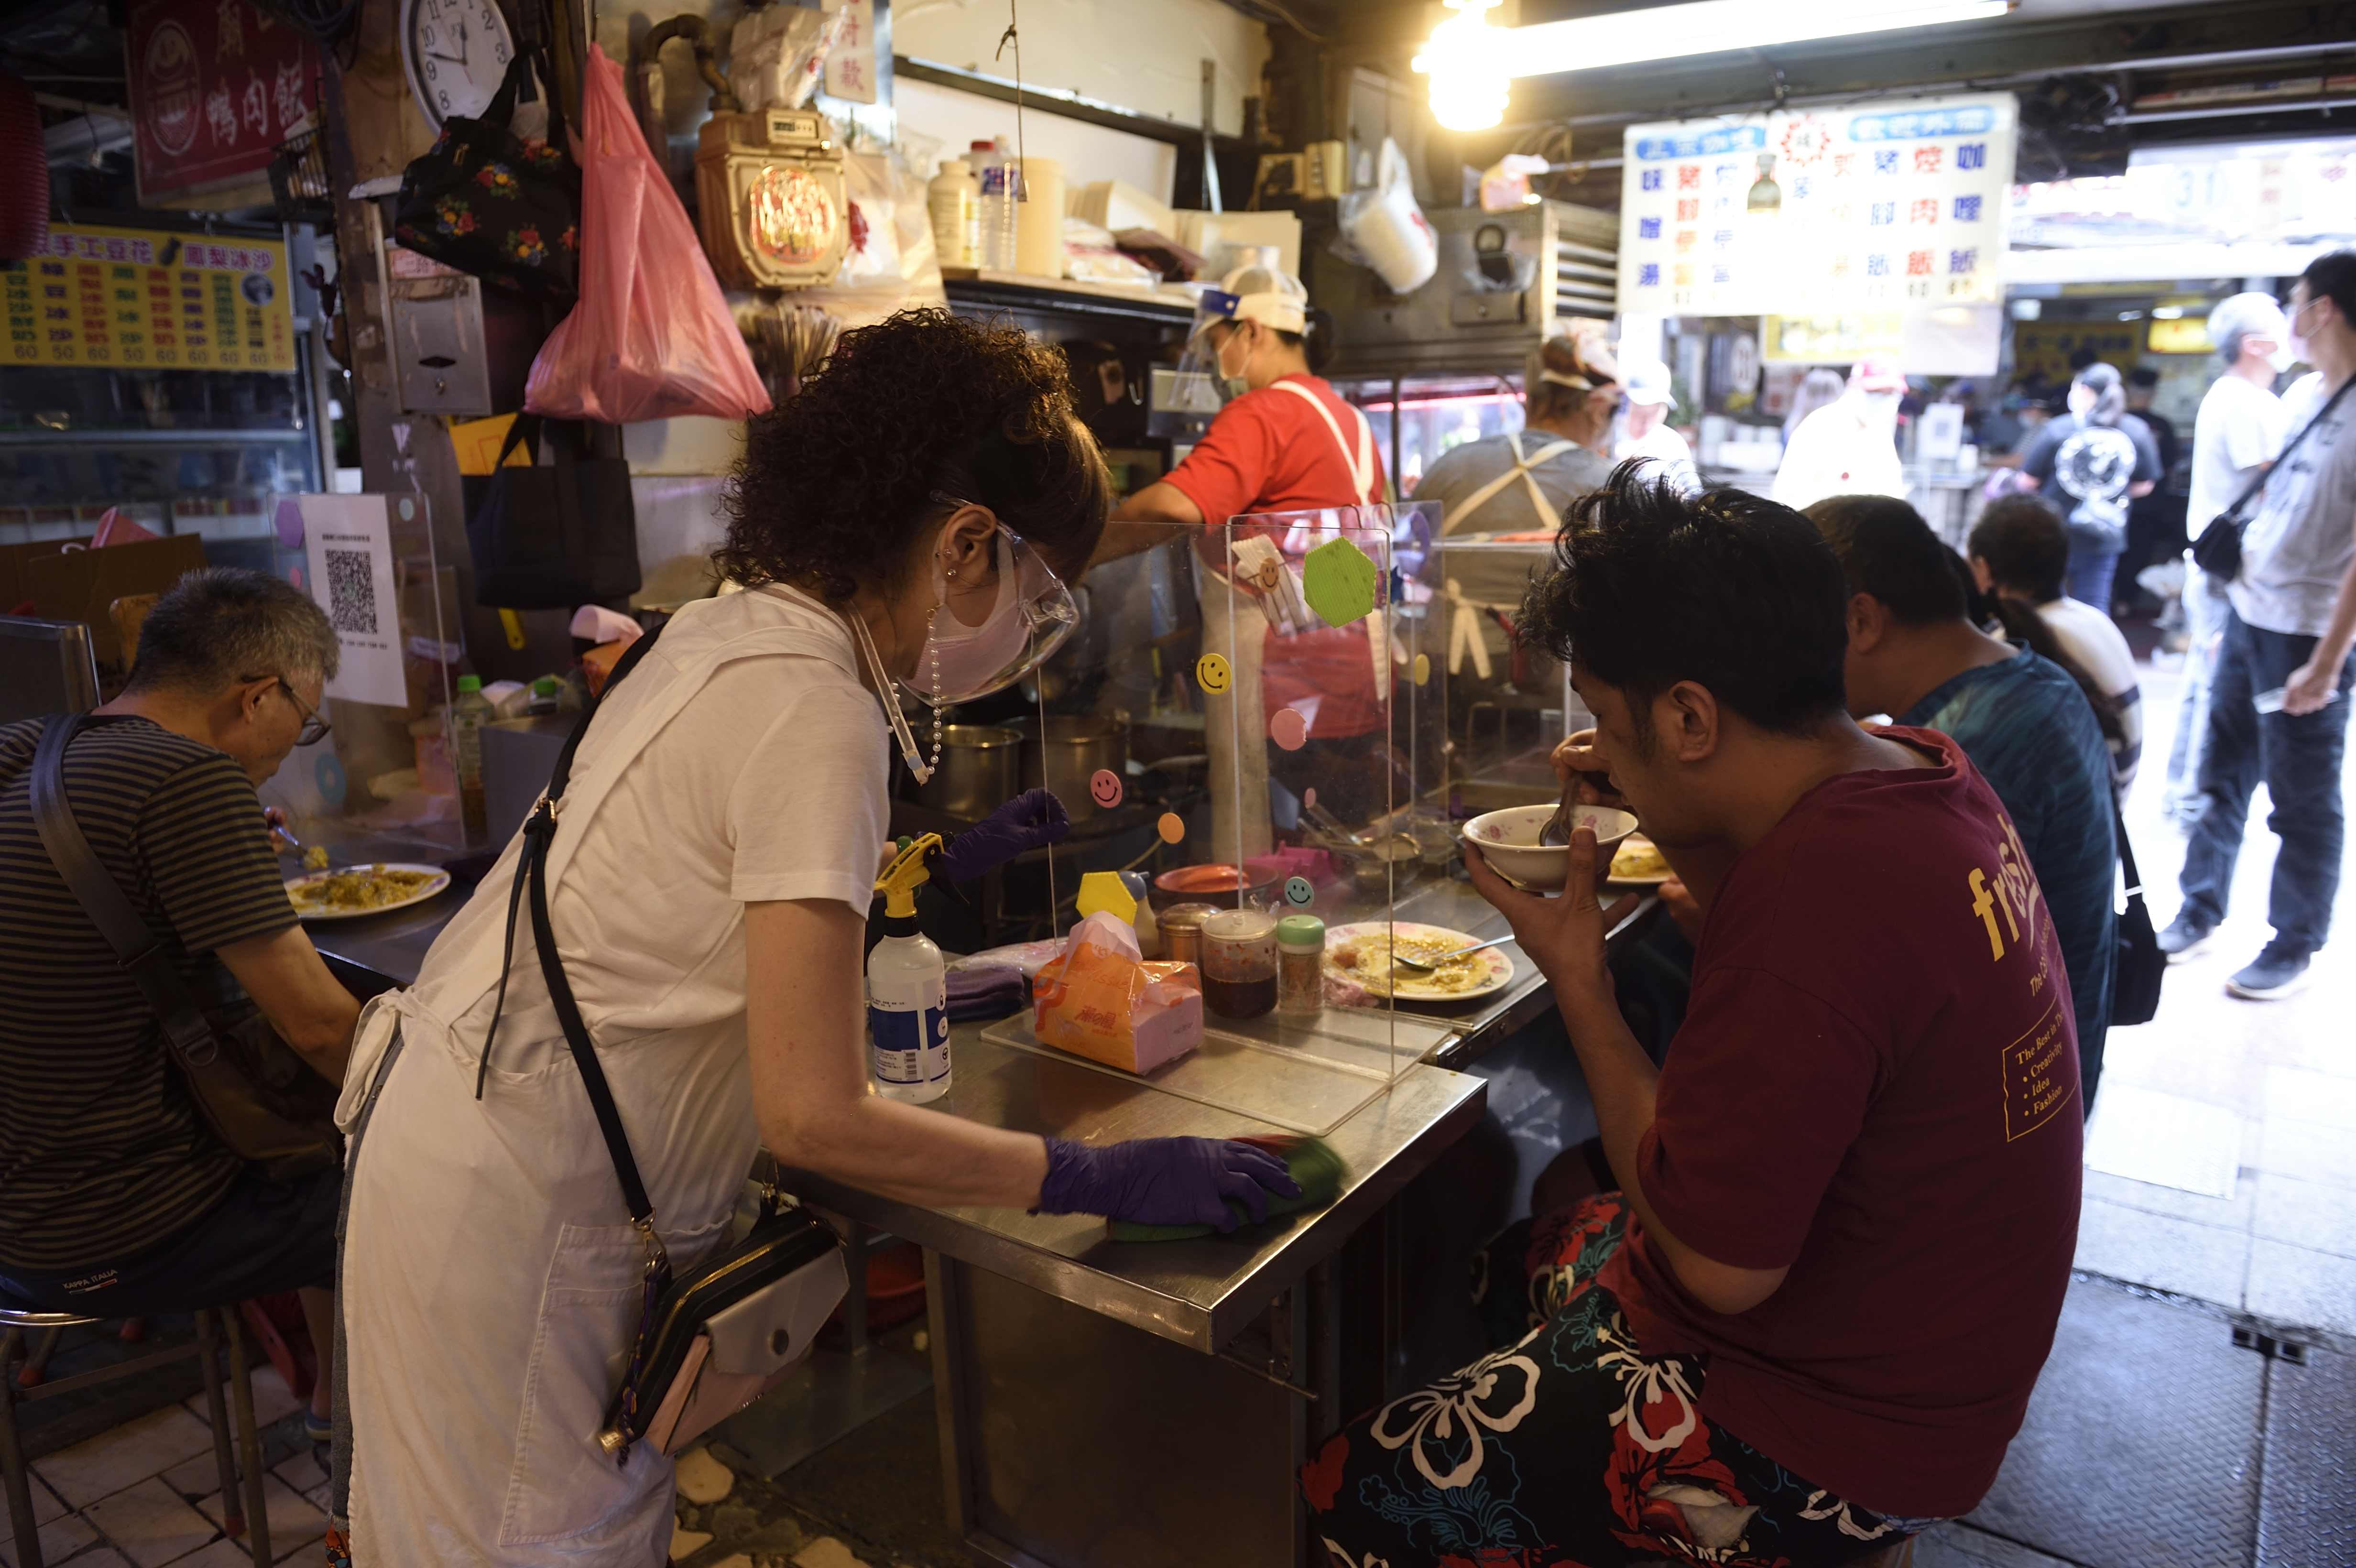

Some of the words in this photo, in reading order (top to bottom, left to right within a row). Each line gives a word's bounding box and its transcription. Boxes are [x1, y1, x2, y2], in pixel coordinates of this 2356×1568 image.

[481, 9, 494, 31] 2
[421, 25, 436, 47] 10
[495, 43, 507, 65] 3
[425, 60, 437, 81] 9
[438, 89, 450, 111] 8
[1638, 167, 1665, 288] 味噌湯
[31, 233, 155, 265] 手工豆花
[2015, 1046, 2035, 1066] The
[2036, 1030, 2051, 1051] Best
[2050, 1024, 2057, 1035] in
[2030, 1041, 2062, 1078] Creativity
[2032, 1076, 2051, 1098] Idea
[2033, 1084, 2063, 1115] Fashion
[62, 1279, 90, 1289] KAPPA
[90, 1269, 118, 1283] ITALIA
